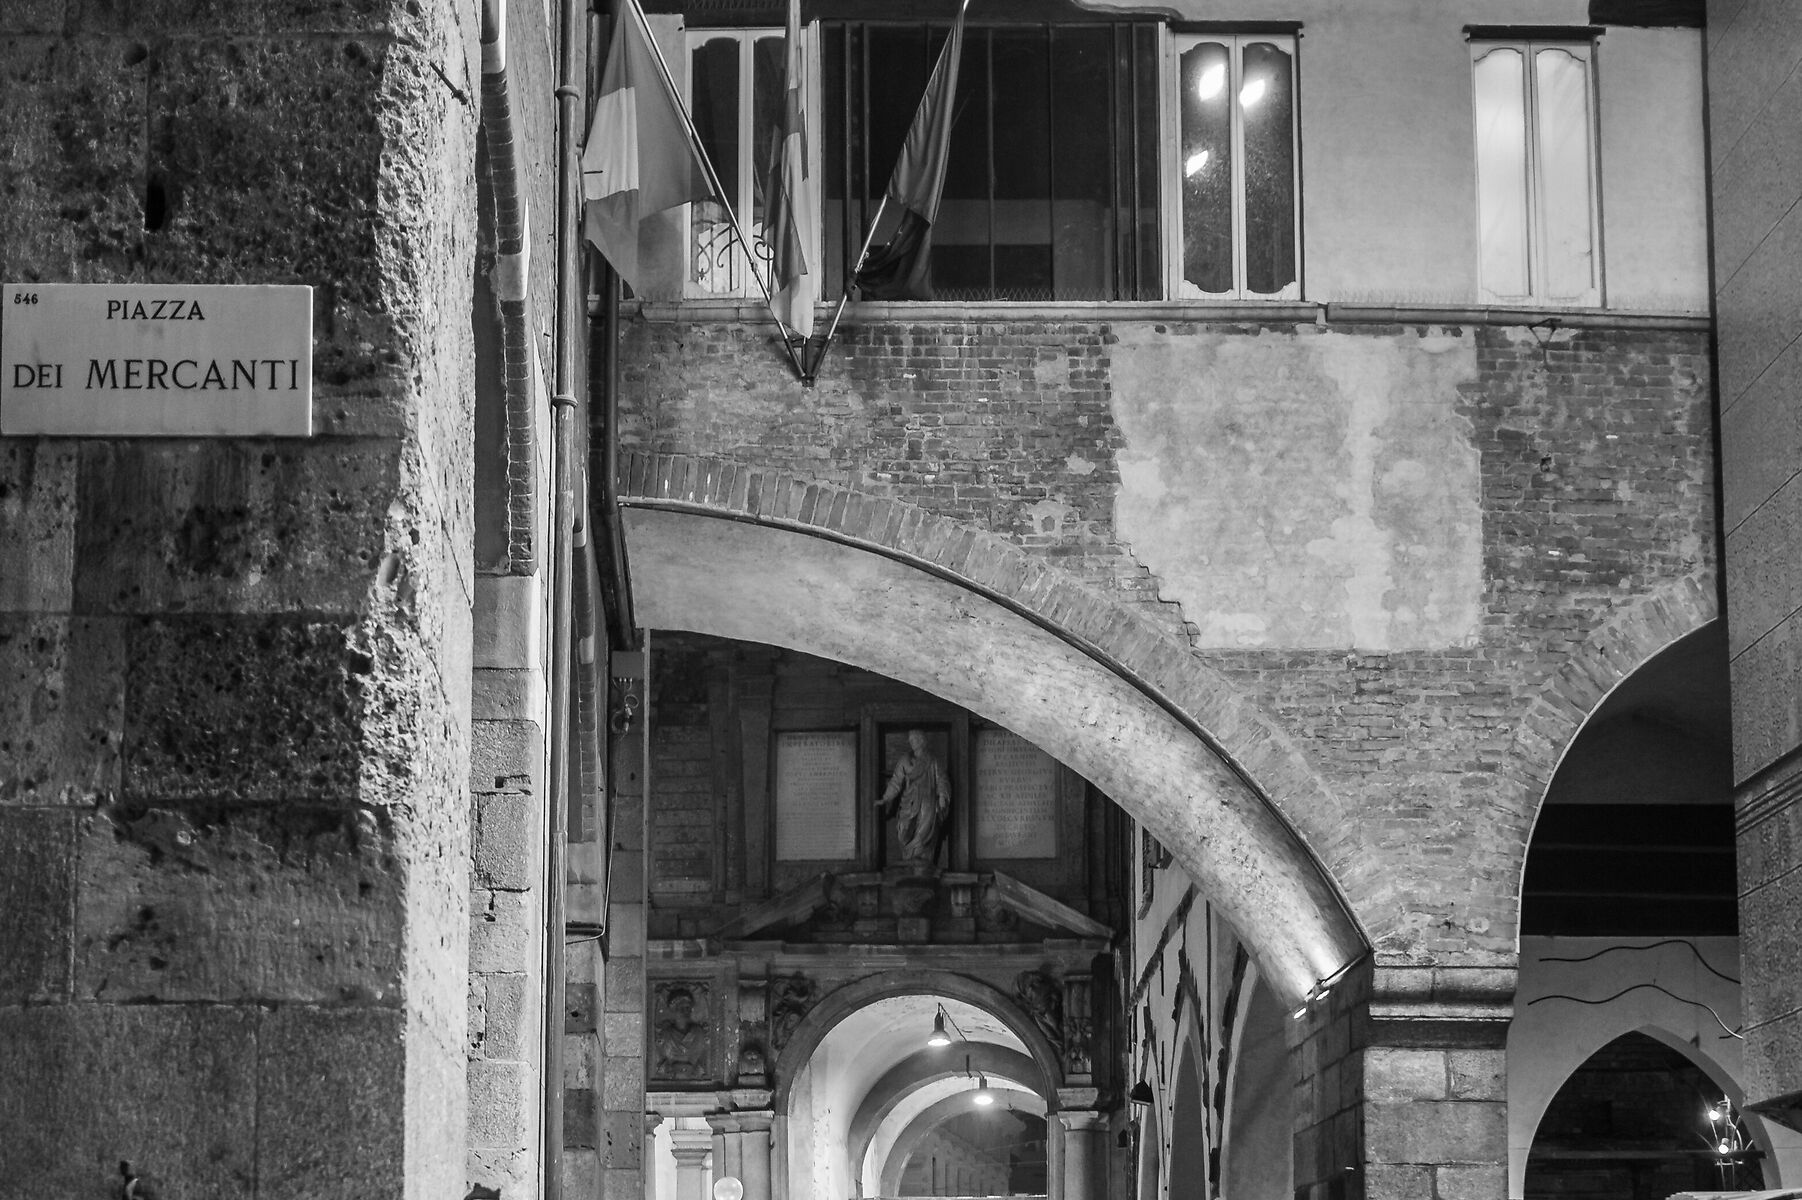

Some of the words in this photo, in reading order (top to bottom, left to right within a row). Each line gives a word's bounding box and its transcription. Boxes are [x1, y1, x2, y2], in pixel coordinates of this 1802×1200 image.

[13, 293, 39, 305] 546
[106, 299, 206, 321] PIAZZA
[12, 363, 63, 389] DEI
[85, 358, 299, 391] MERCANTI
